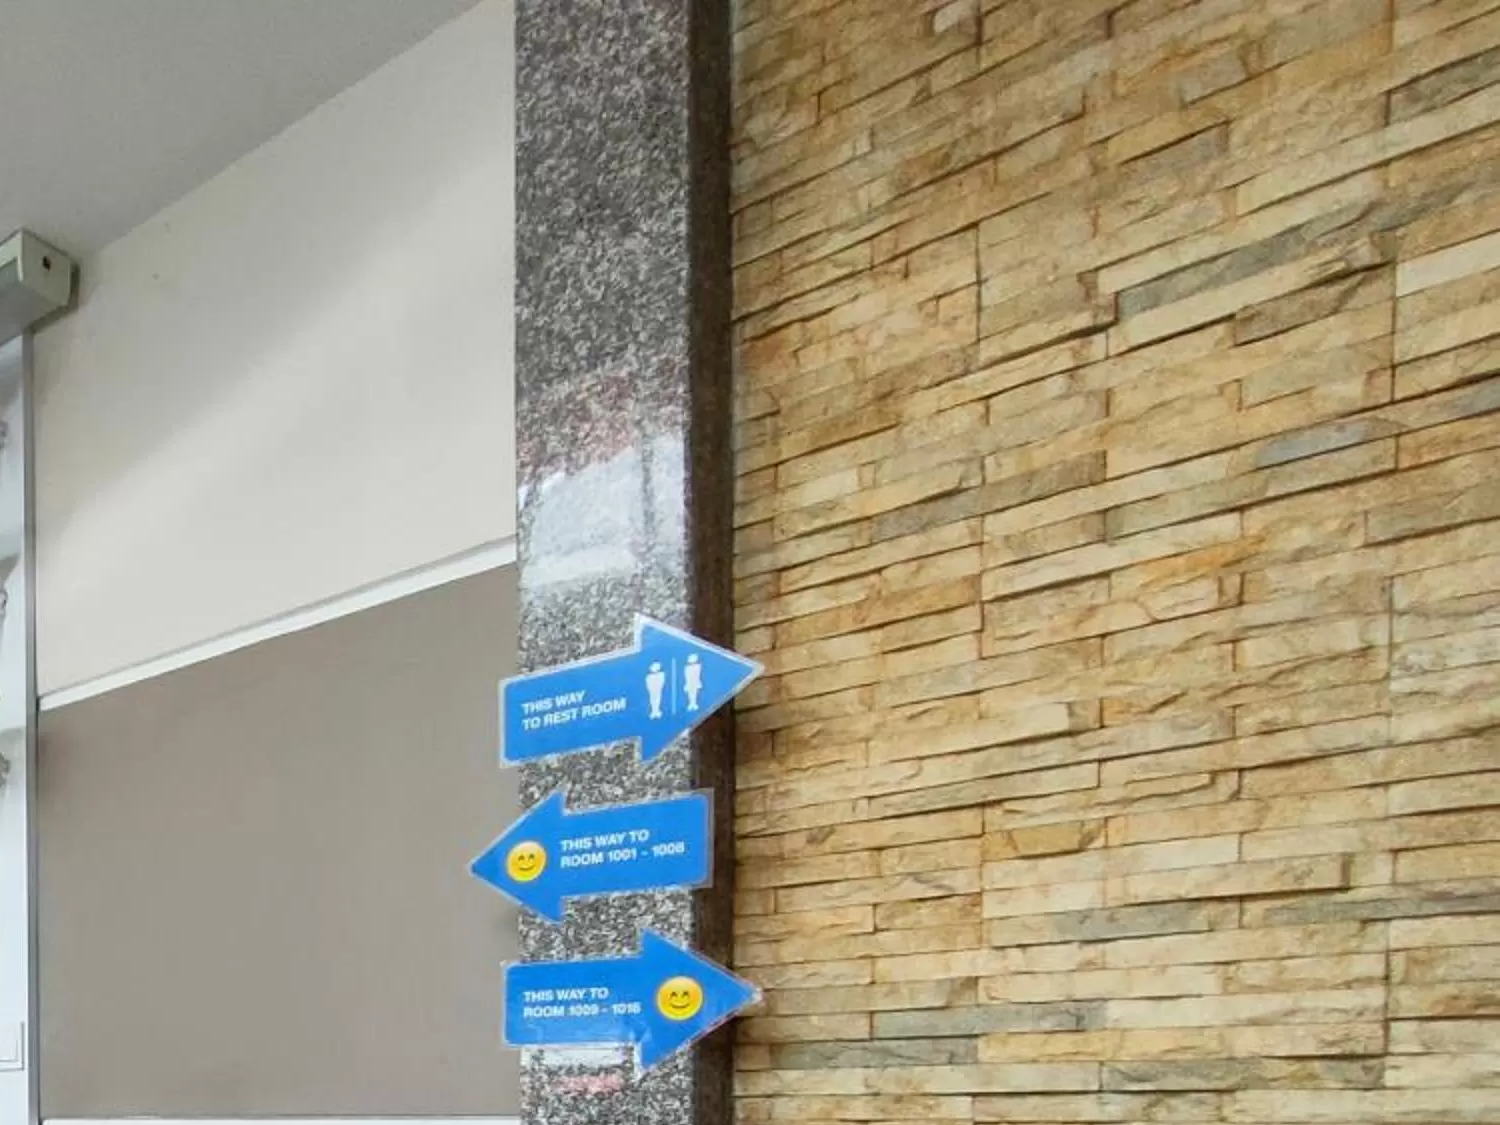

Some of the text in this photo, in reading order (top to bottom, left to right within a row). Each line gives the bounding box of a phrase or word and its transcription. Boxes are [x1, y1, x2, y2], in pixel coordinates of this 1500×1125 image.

[522, 690, 586, 715] THIS WAY
[522, 697, 627, 731] TO REST ROOM
[560, 828, 650, 851] THIS WAY TO
[560, 851, 605, 868] ROOM
[607, 847, 637, 862] 1001
[523, 986, 609, 1003] THIS WAY TO
[523, 1004, 565, 1018] ROOM
